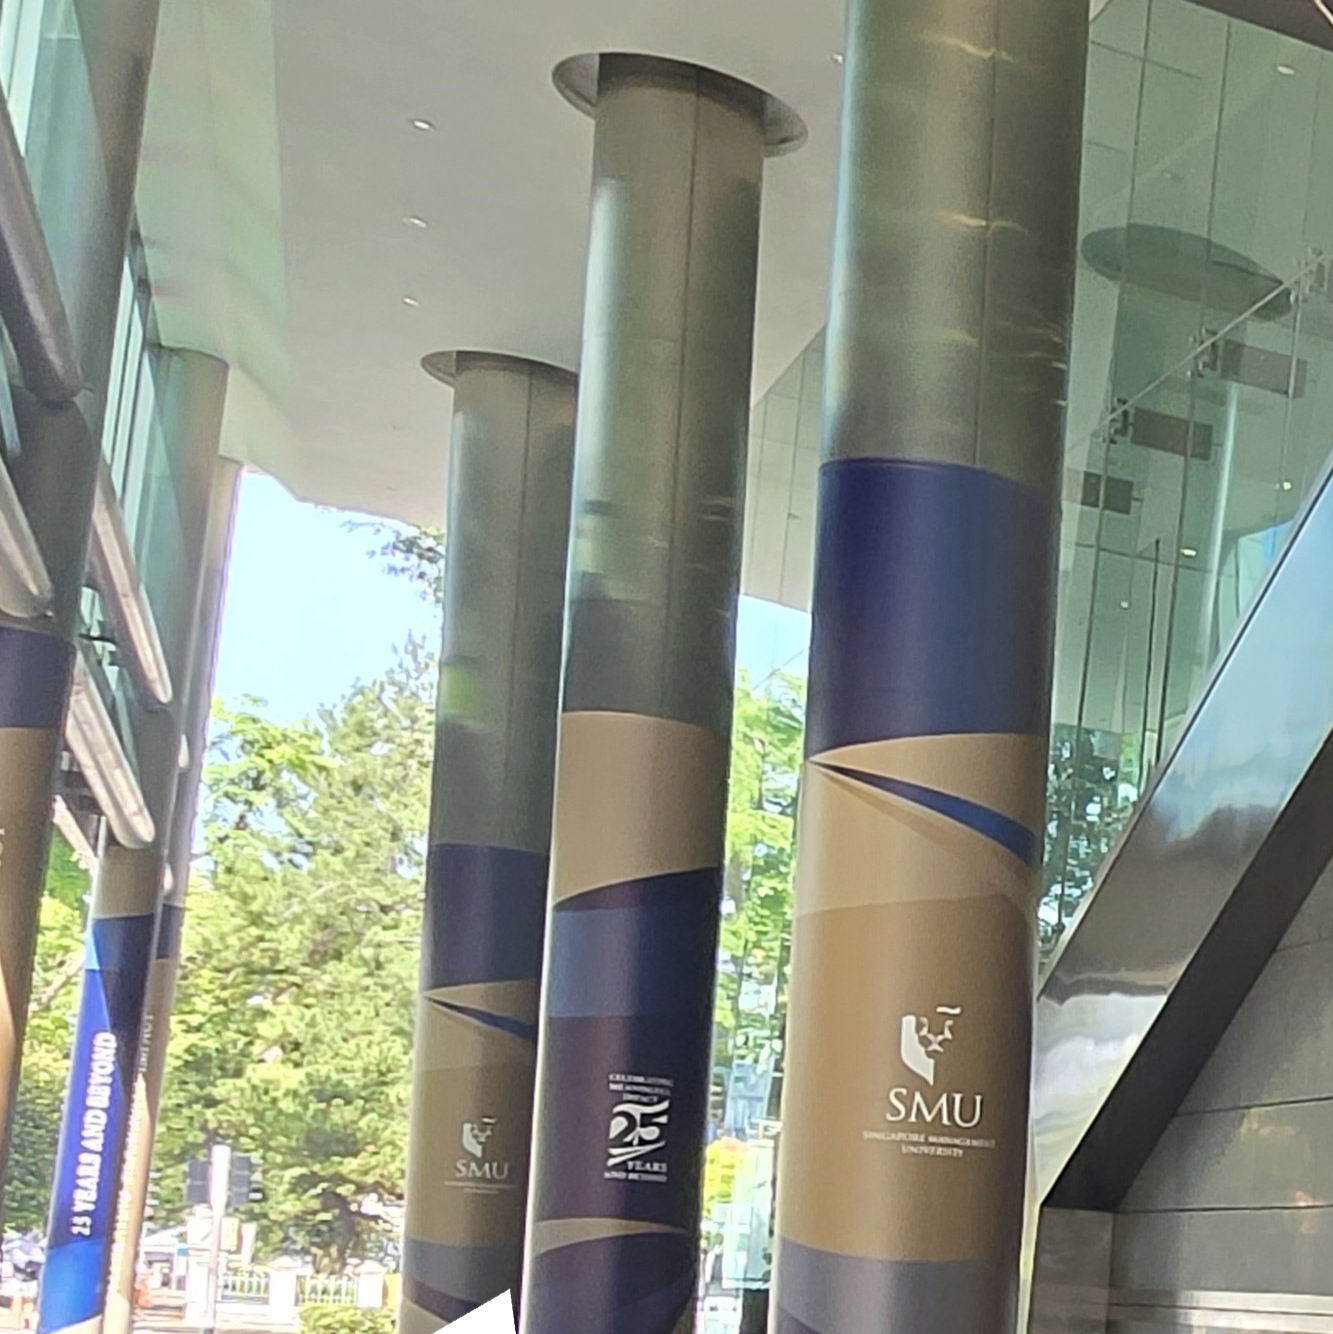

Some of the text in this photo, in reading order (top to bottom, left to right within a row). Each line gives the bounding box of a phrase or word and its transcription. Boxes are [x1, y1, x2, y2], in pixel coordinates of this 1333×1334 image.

[85, 1031, 117, 1108] BEYOND
[886, 1087, 983, 1128] SMU
[81, 1108, 108, 1151] AND
[72, 1153, 102, 1212] YEARS
[456, 1160, 509, 1180] SMU
